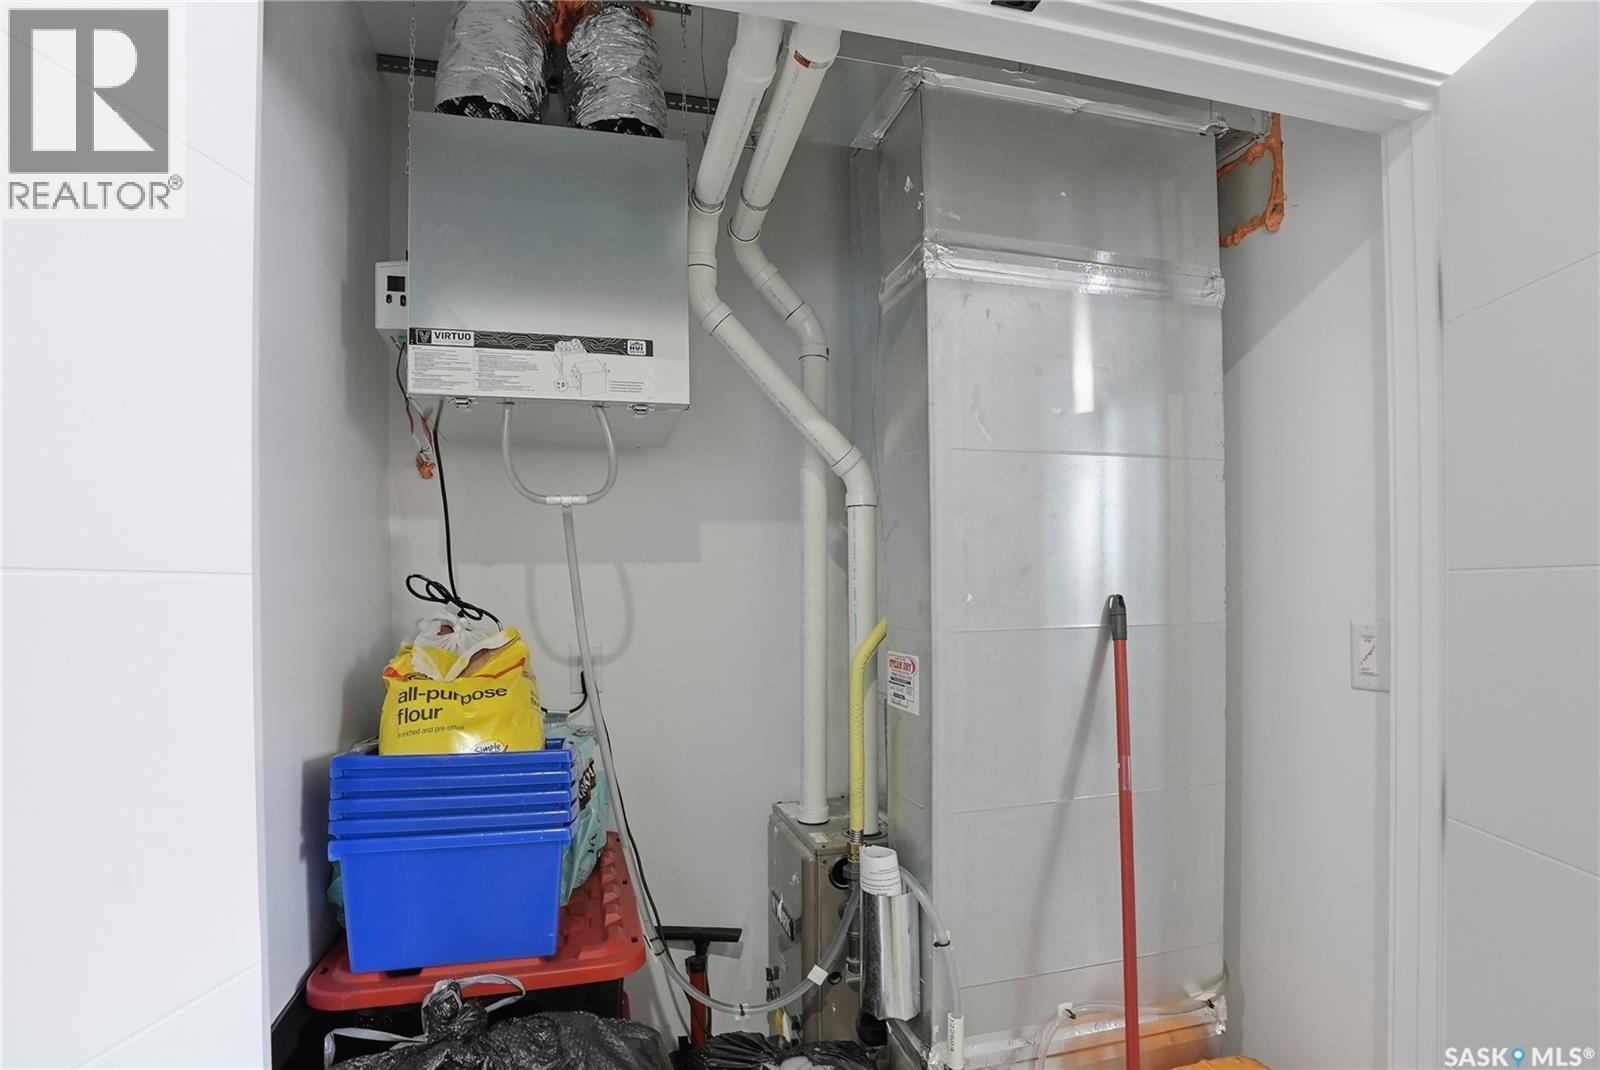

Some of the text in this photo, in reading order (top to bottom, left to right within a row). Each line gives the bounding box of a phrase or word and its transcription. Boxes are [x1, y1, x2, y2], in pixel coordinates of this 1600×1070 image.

[434, 331, 471, 341] VIRTUO
[398, 686, 507, 706] all-purpose
[397, 706, 443, 726] flour
[421, 726, 434, 735] and
